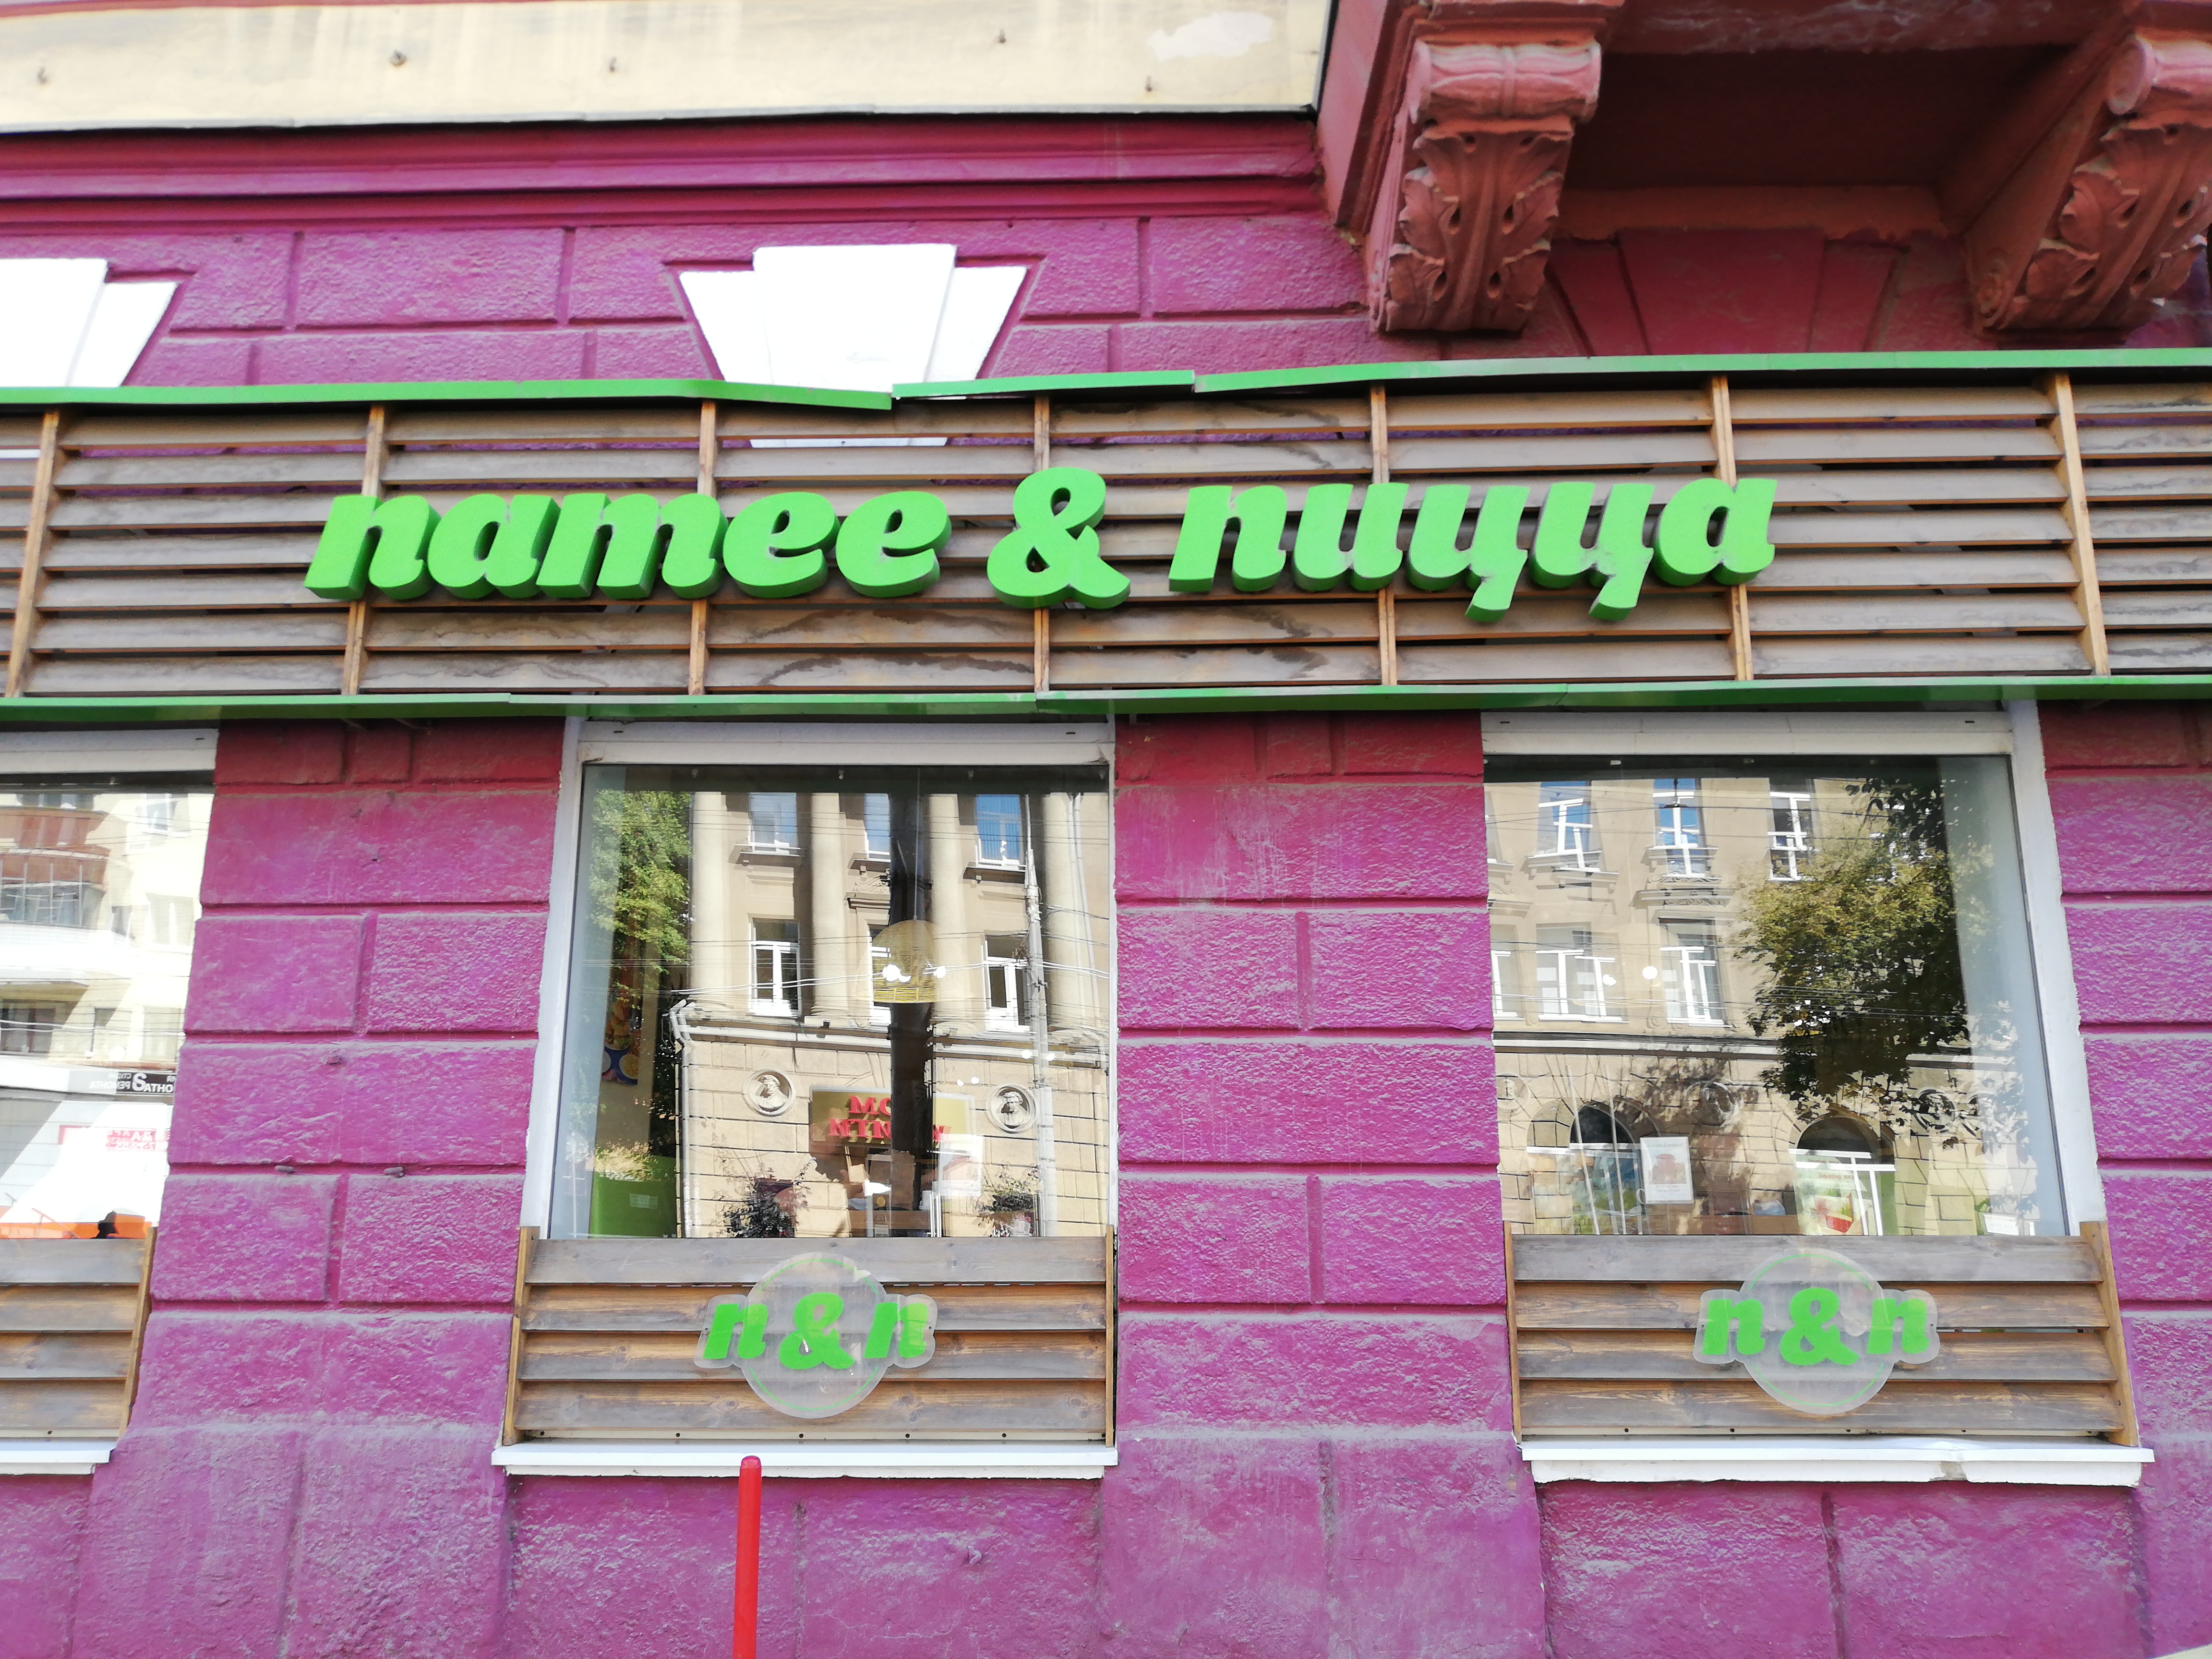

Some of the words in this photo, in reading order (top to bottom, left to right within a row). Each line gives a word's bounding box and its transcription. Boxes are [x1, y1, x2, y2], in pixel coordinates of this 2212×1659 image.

[986, 467, 1131, 610] &
[1168, 478, 1778, 622] пицца
[779, 1292, 855, 1370] &
[1779, 1287, 1859, 1366] &
